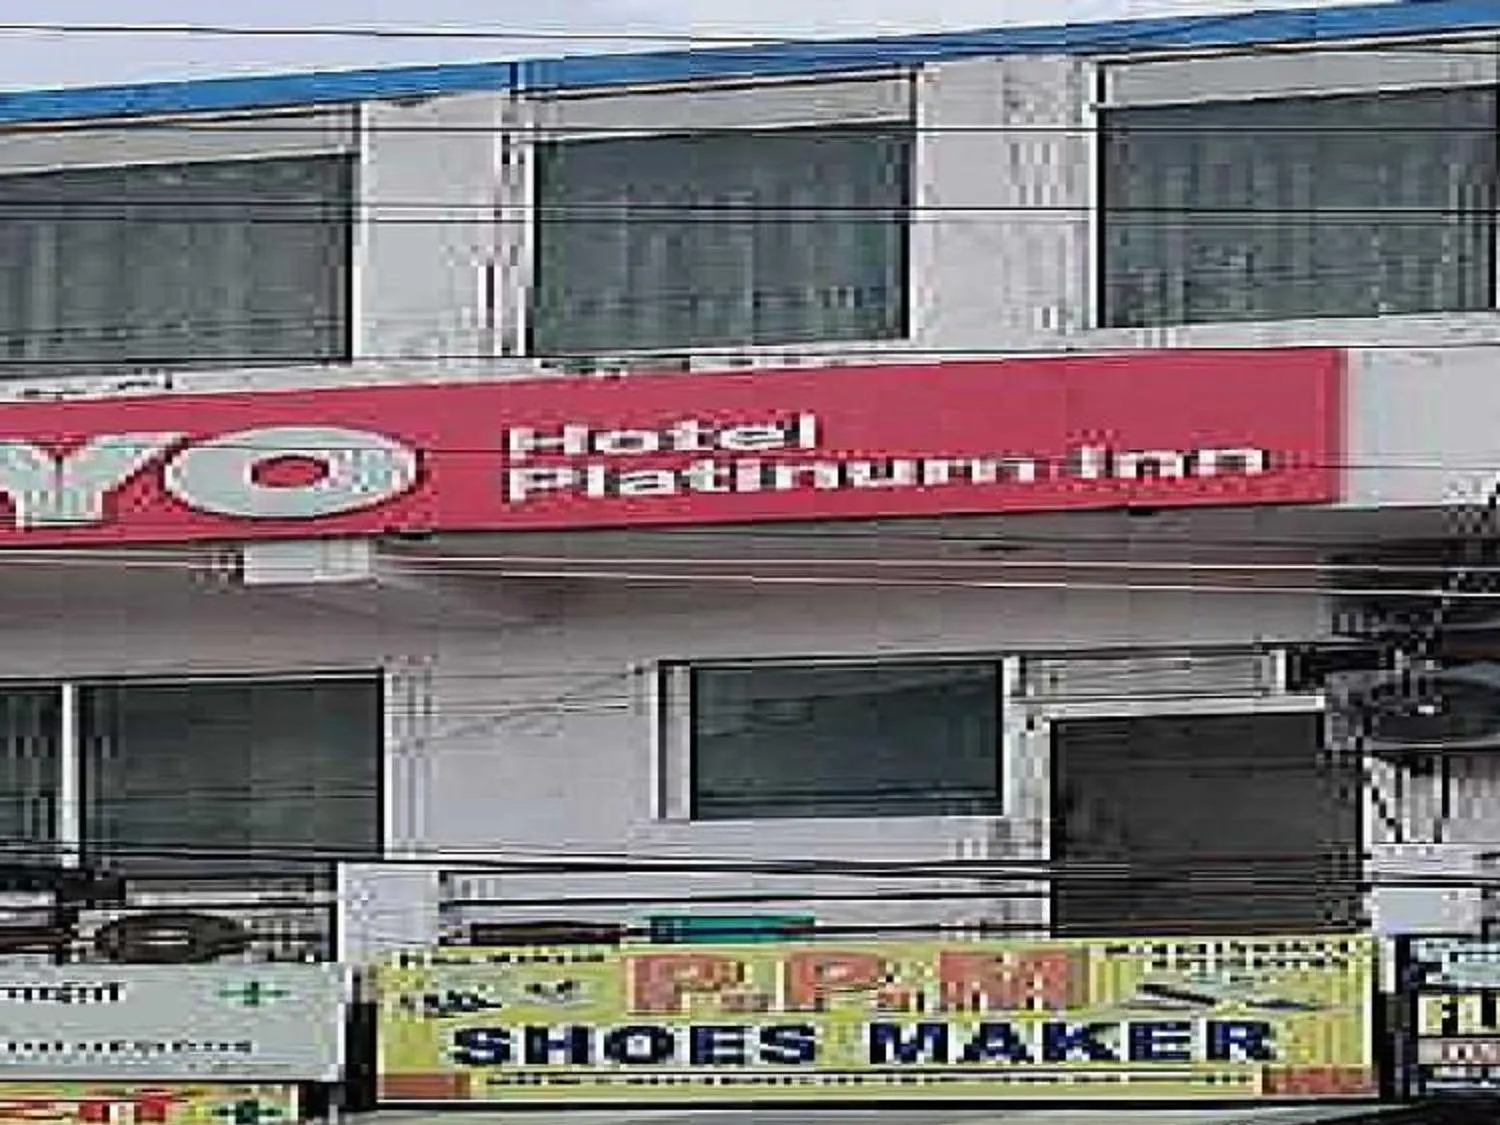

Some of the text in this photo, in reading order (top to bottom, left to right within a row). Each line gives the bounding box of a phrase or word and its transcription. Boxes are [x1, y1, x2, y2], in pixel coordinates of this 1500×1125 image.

[506, 413, 818, 459] Hotel
[506, 445, 1266, 503] Platinum Inn
[450, 1019, 1277, 1067] SHOES MAKER
